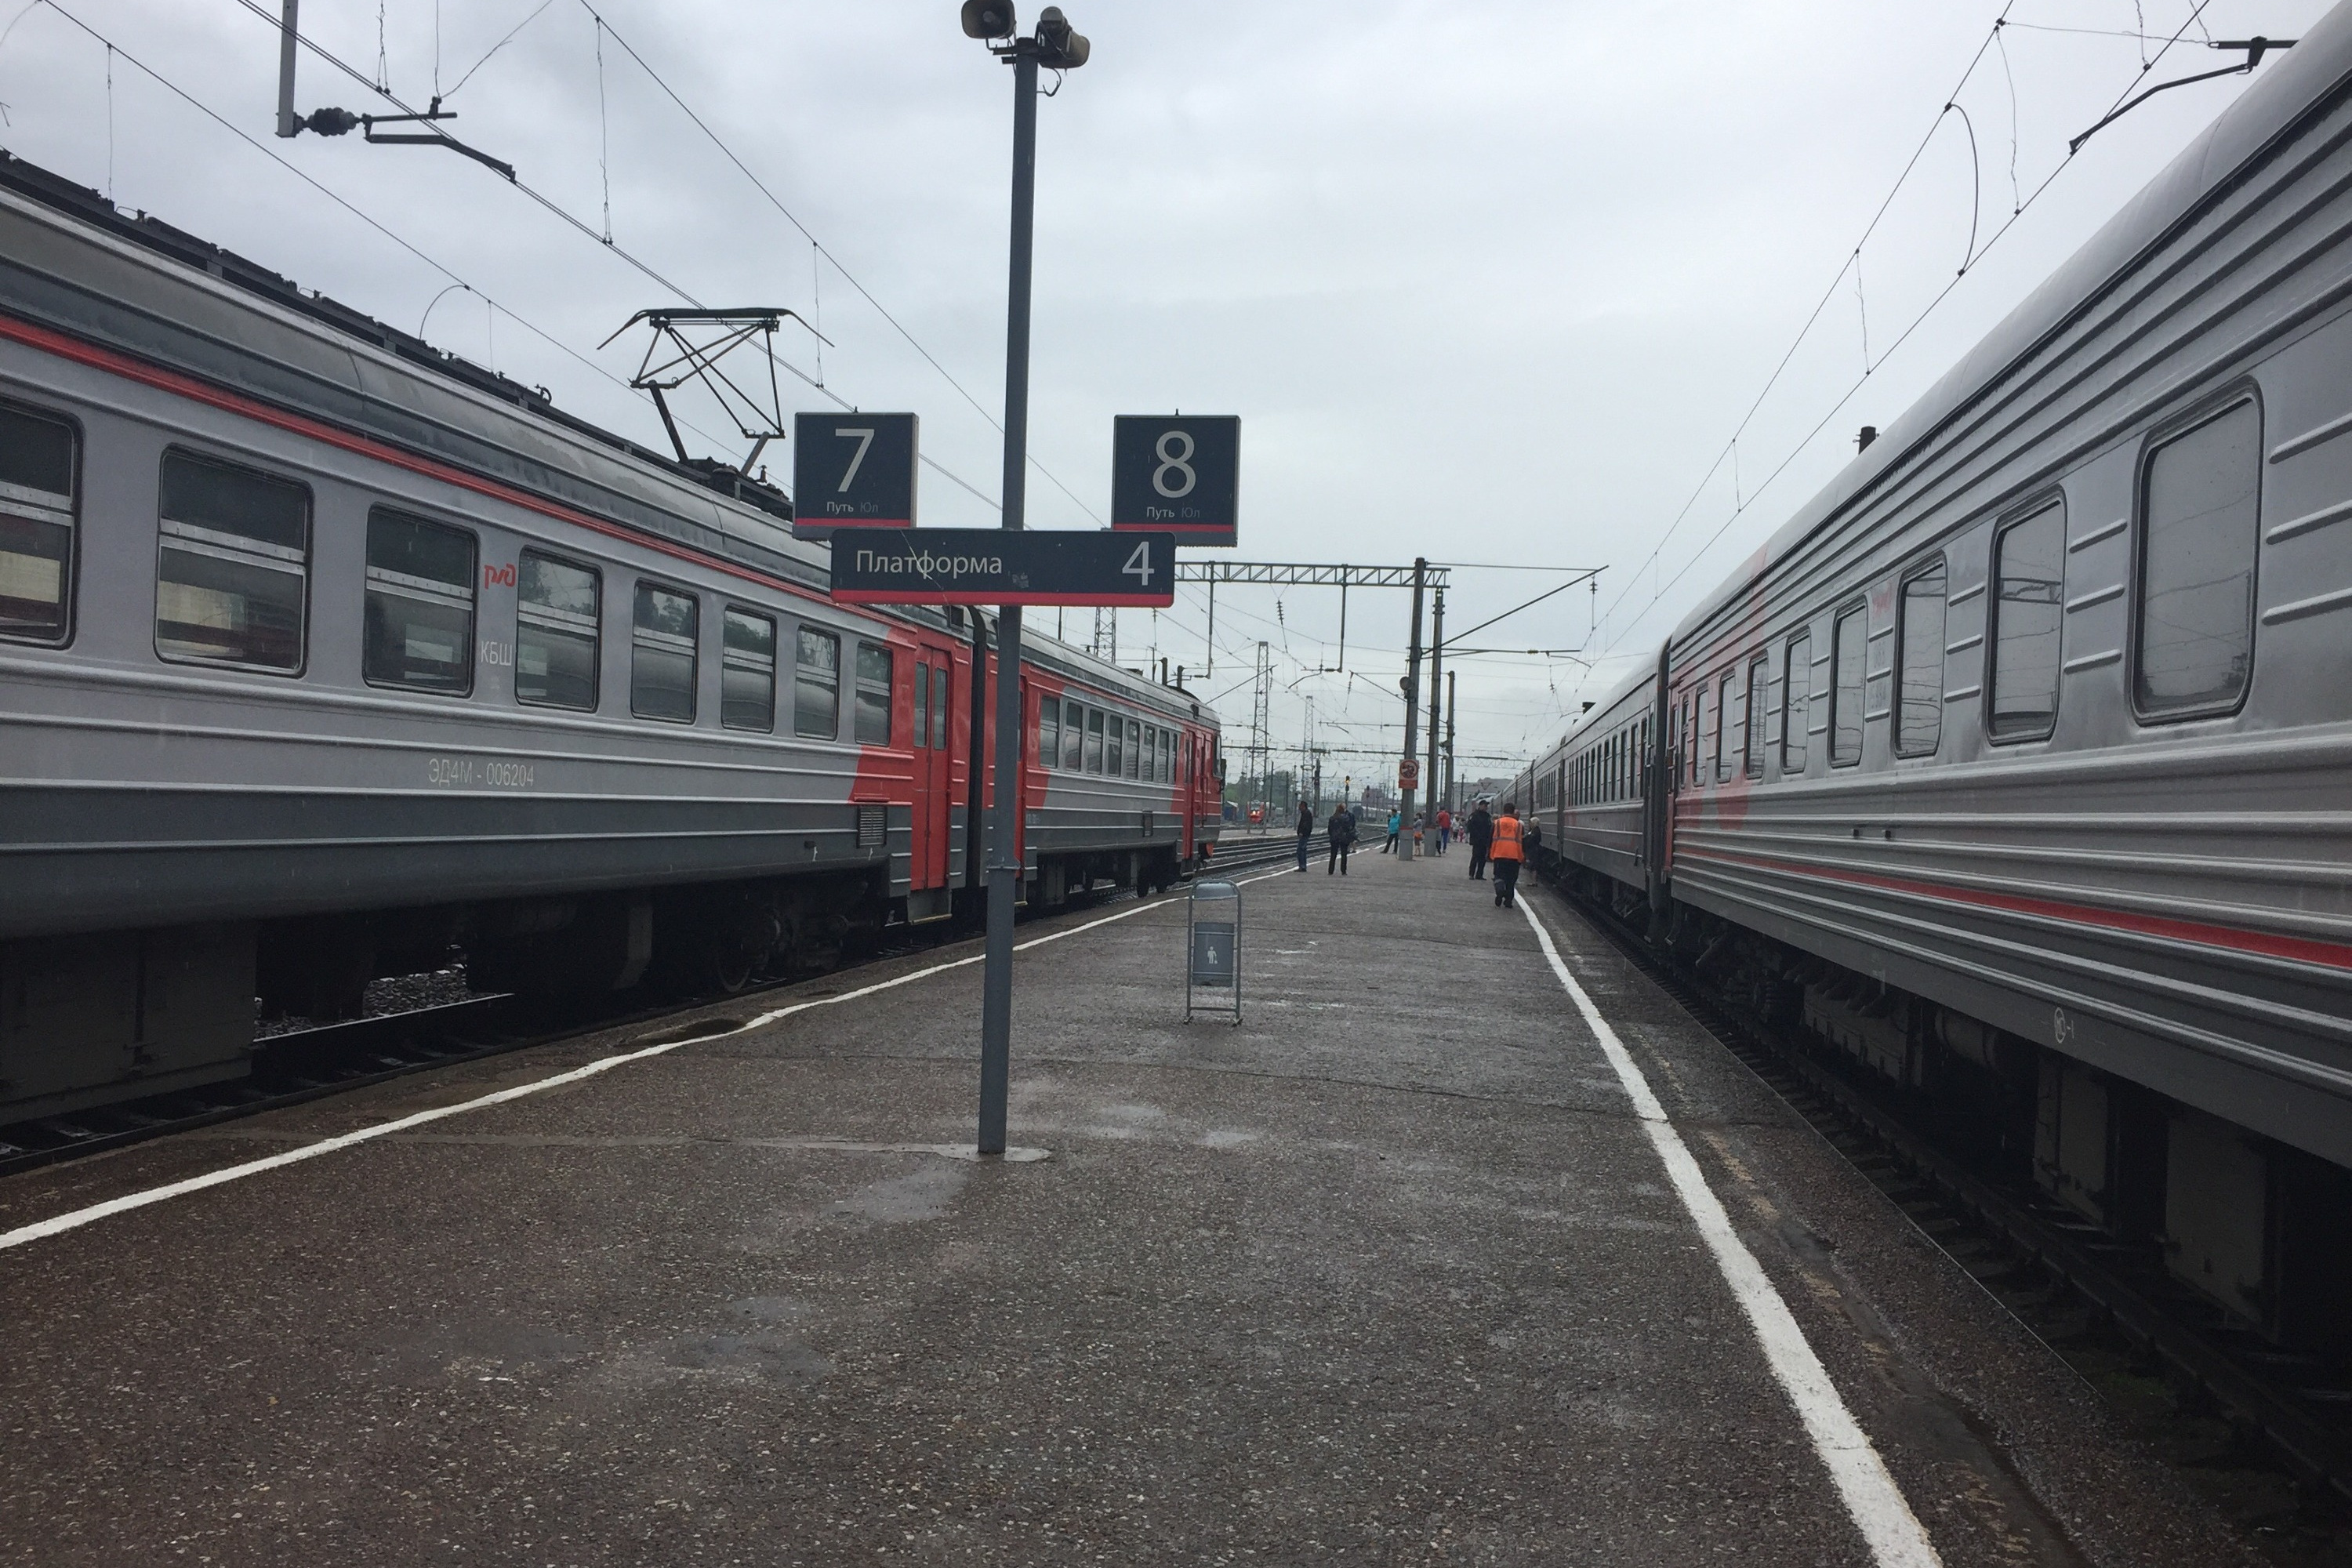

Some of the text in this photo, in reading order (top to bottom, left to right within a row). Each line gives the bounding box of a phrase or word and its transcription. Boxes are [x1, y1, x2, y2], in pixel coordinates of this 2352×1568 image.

[835, 428, 875, 492] 7
[1152, 430, 1196, 499] 8
[826, 502, 855, 515] Путь
[1147, 506, 1175, 521] Путь
[856, 541, 1156, 586] Платформа 4
[481, 641, 513, 666] КБШ
